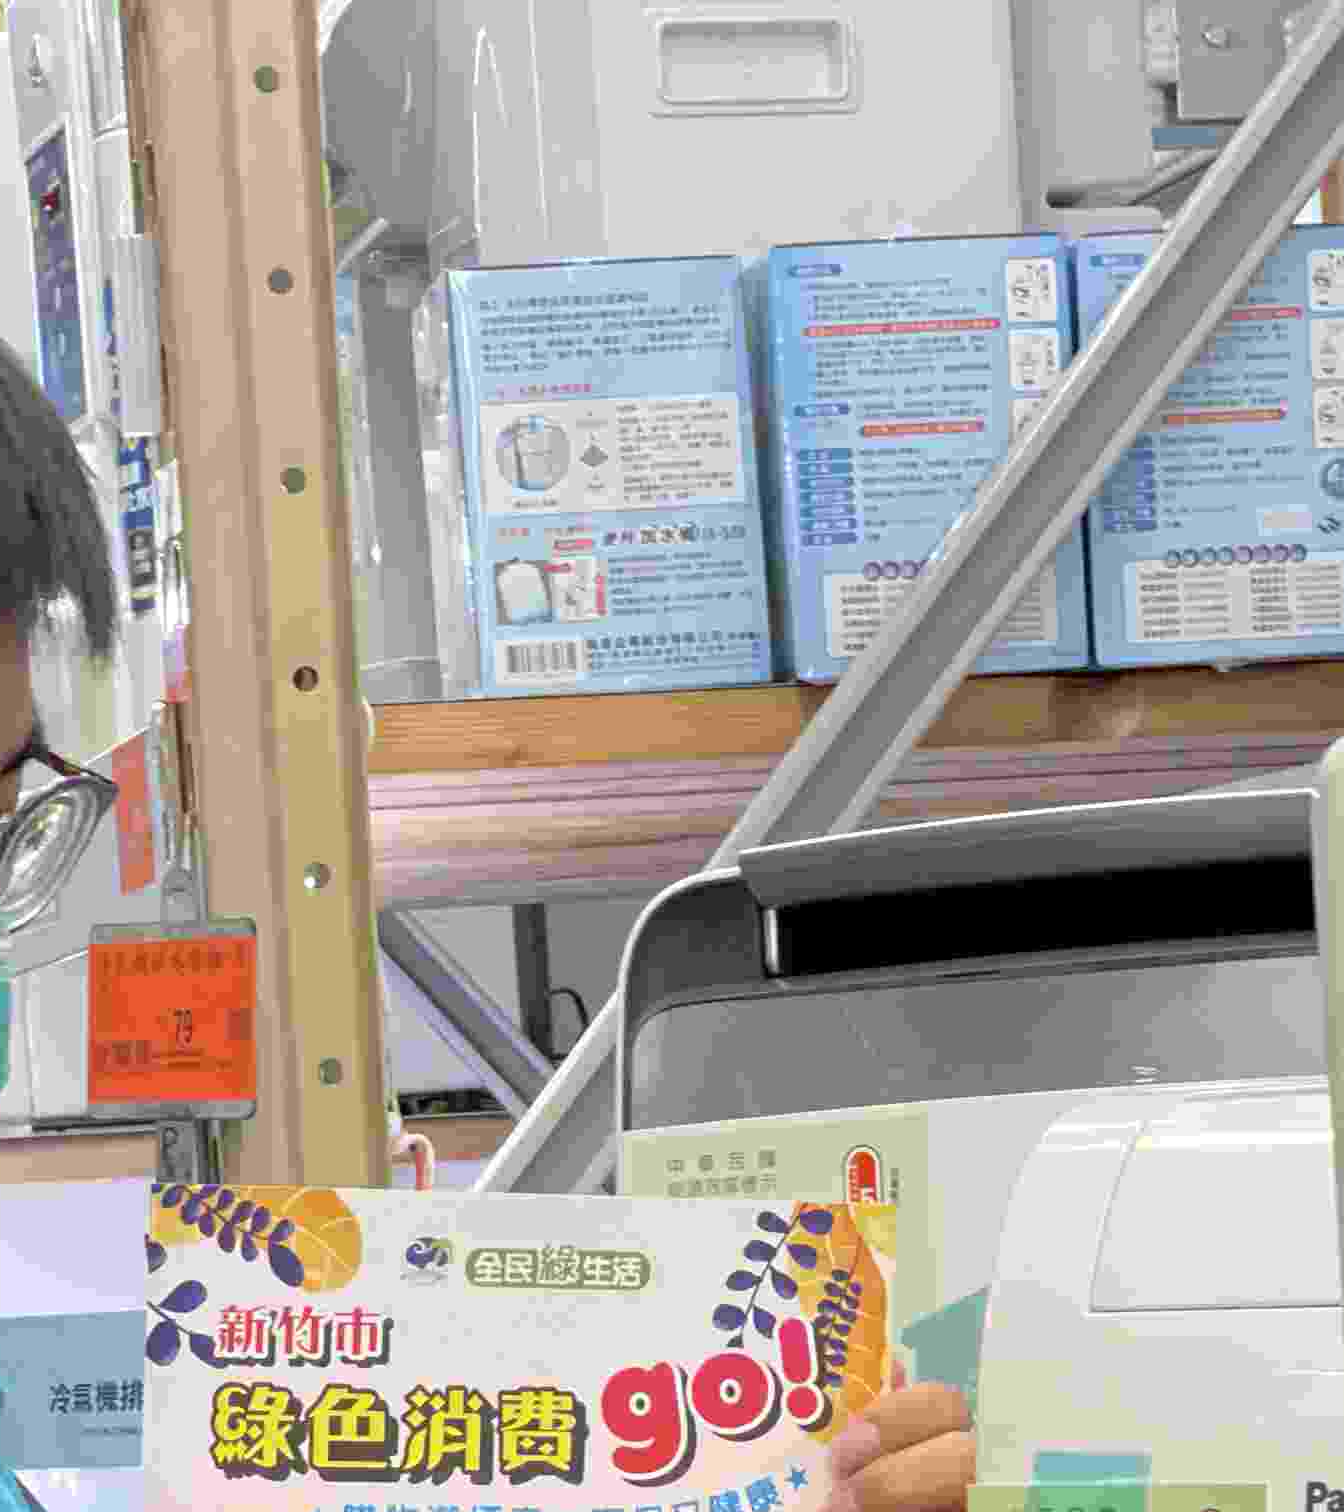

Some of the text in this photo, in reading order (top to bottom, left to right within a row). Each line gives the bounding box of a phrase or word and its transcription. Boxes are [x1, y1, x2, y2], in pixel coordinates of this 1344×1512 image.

[473, 1242, 644, 1289] 全民綠生活
[217, 1304, 385, 1365] 新竹市
[211, 1316, 824, 1487] 綠色消費 go!
